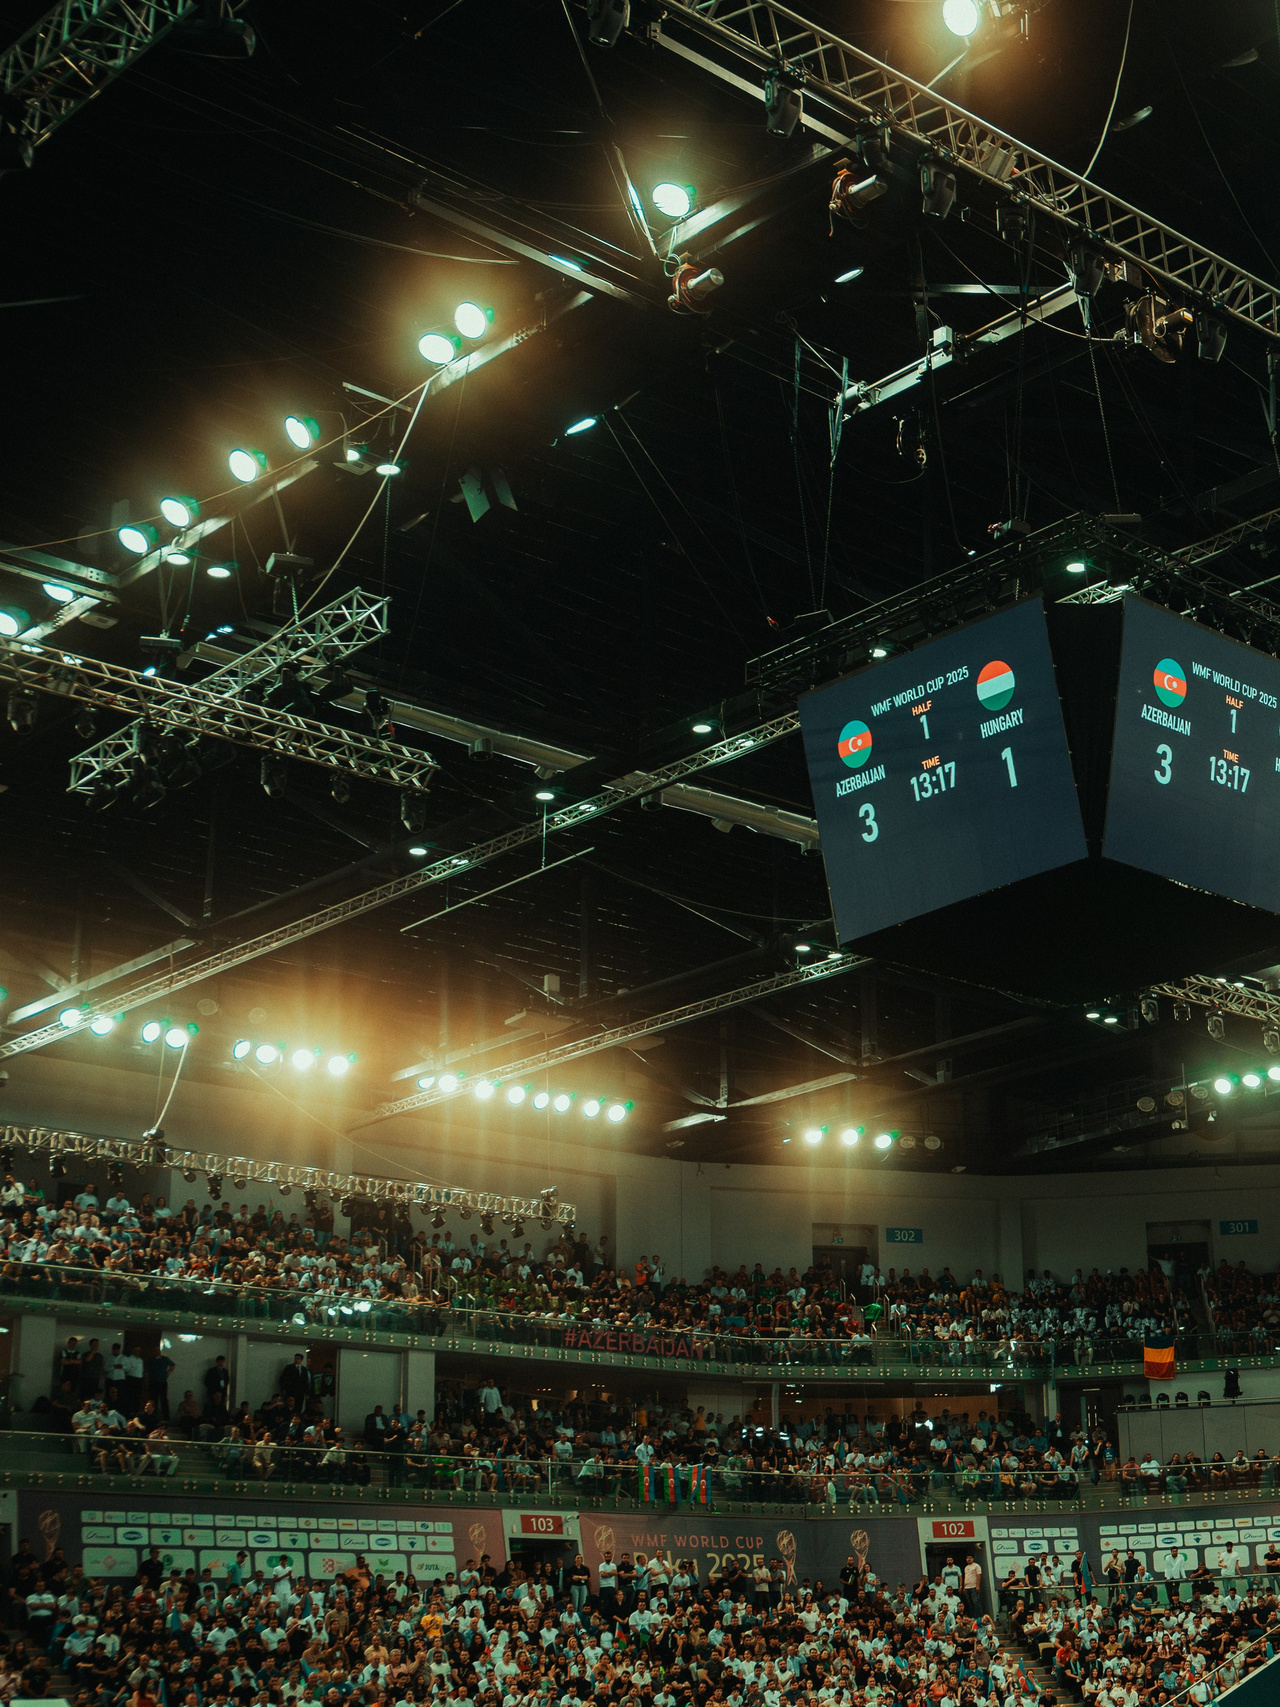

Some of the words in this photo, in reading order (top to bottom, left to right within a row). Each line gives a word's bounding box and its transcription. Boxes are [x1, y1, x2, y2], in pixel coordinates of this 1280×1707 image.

[870, 698, 892, 717] WMF
[892, 684, 925, 708] WORLD
[926, 676, 945, 693] CUP
[946, 665, 969, 686] 2025
[1192, 661, 1212, 680] WMF
[1212, 670, 1241, 693] WORLD
[1241, 684, 1258, 699] CUP
[1259, 691, 1278, 709] 2025
[911, 700, 932, 716] HALF
[1225, 695, 1244, 709] HALF
[920, 714, 930, 740] 1
[979, 708, 1024, 739] HUNGARY
[1141, 703, 1191, 737] AZERBAIJAN
[1230, 709, 1237, 734] 1
[921, 755, 940, 770] TIME
[1001, 746, 1018, 788] 1
[1154, 743, 1173, 785] 3
[1223, 749, 1239, 763] TIME
[836, 764, 886, 798] AZERBAIJAN
[910, 761, 956, 802] 13:17
[1209, 756, 1250, 793] 13:17
[858, 802, 879, 843] 3
[894, 1230, 916, 1242] 302
[1229, 1222, 1250, 1234] 301
[564, 1327, 704, 1361] #AZERBAIJAN
[530, 1517, 555, 1532] 103
[941, 1522, 966, 1536] 102
[631, 1534, 667, 1548] WMF
[674, 1534, 729, 1549] WORLD
[735, 1536, 764, 1550] CUP
